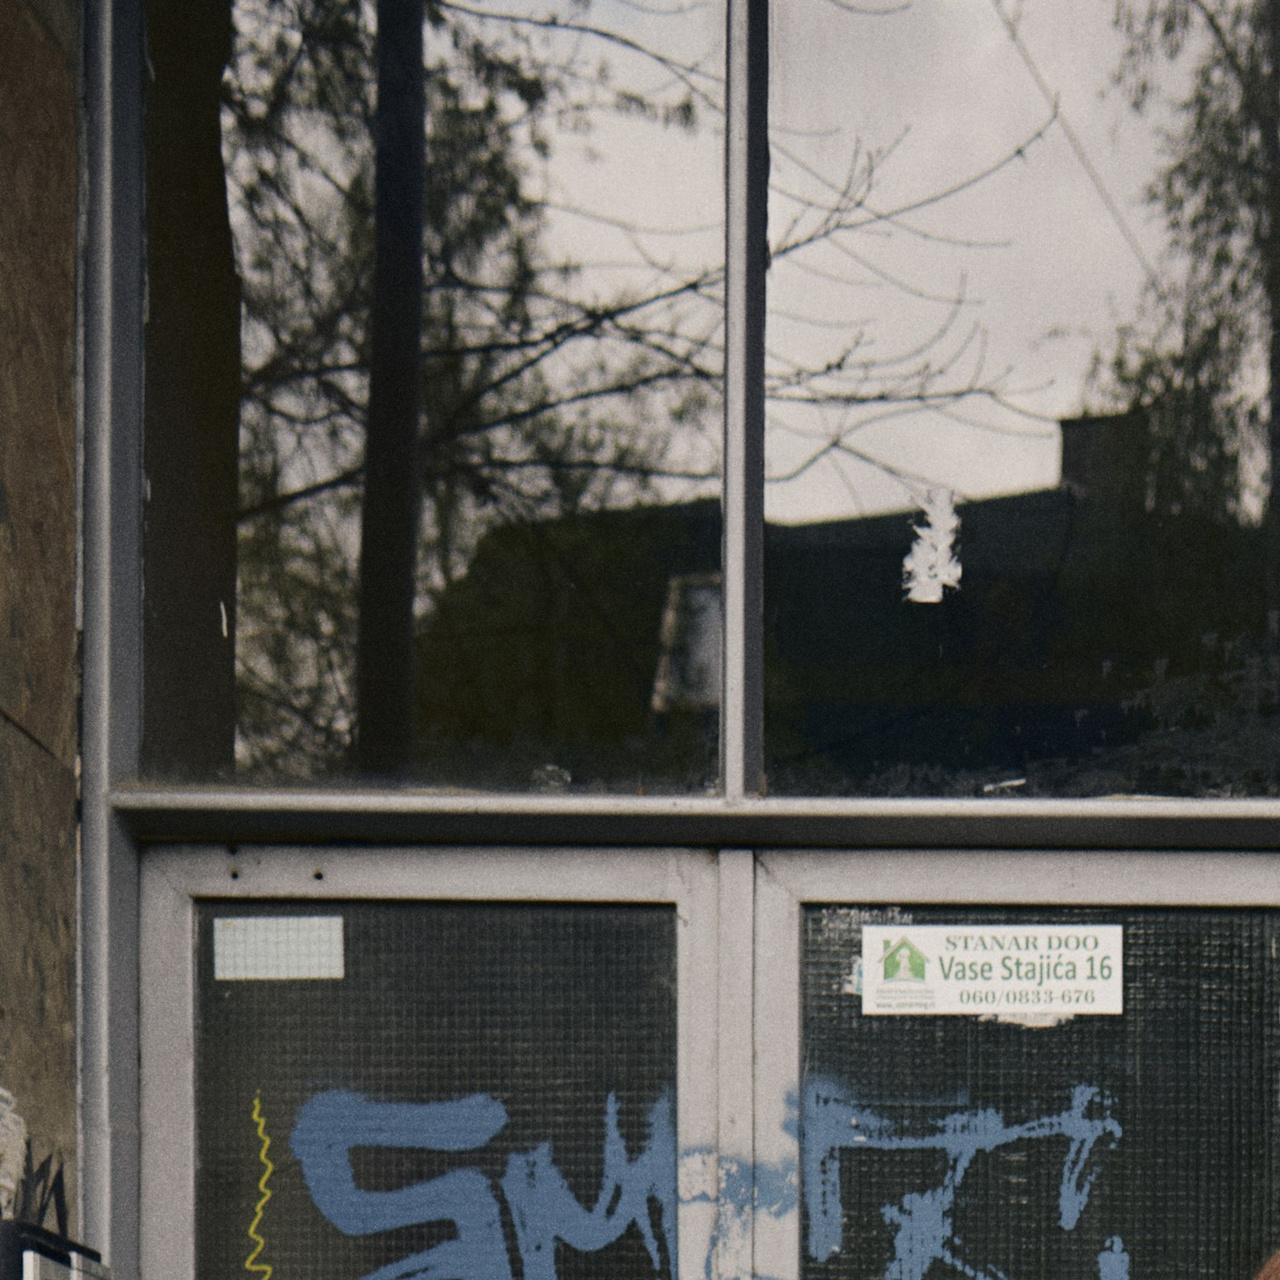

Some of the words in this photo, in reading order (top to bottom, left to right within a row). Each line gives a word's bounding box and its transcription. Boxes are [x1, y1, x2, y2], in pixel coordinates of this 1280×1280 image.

[944, 934, 1039, 951] STANAR
[1047, 934, 1100, 951] DOO
[938, 954, 993, 981] Vase
[1000, 953, 1077, 987] Stajića
[1085, 954, 1113, 981] 16
